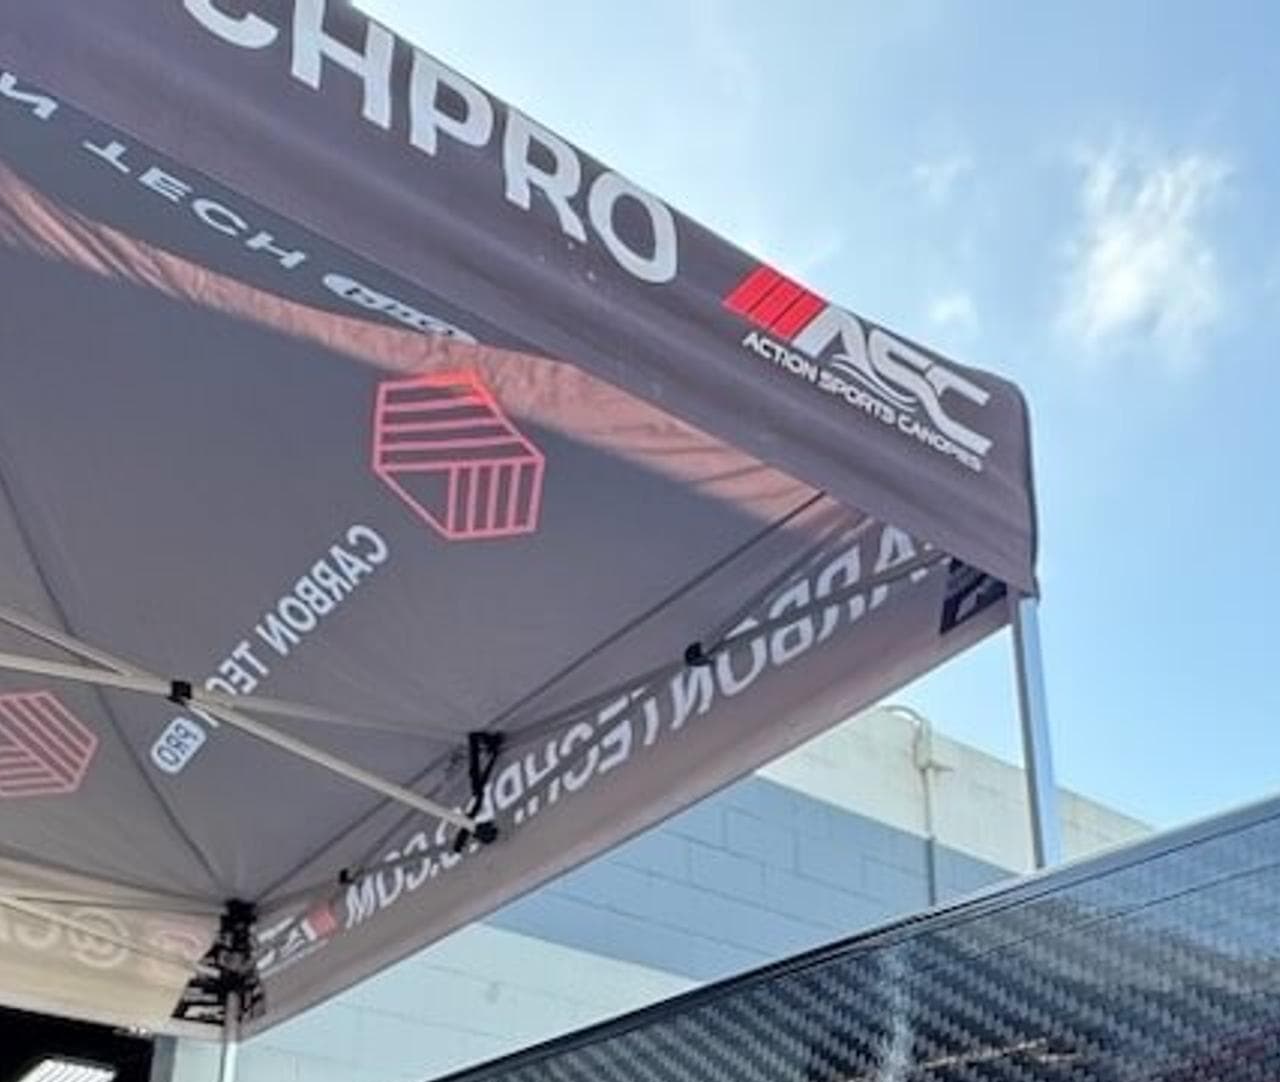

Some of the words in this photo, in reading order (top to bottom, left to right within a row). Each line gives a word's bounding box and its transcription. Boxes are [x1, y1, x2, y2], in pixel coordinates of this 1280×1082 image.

[741, 331, 818, 384] ACTION
[816, 369, 897, 426] SPORTS
[791, 302, 994, 457] ASC
